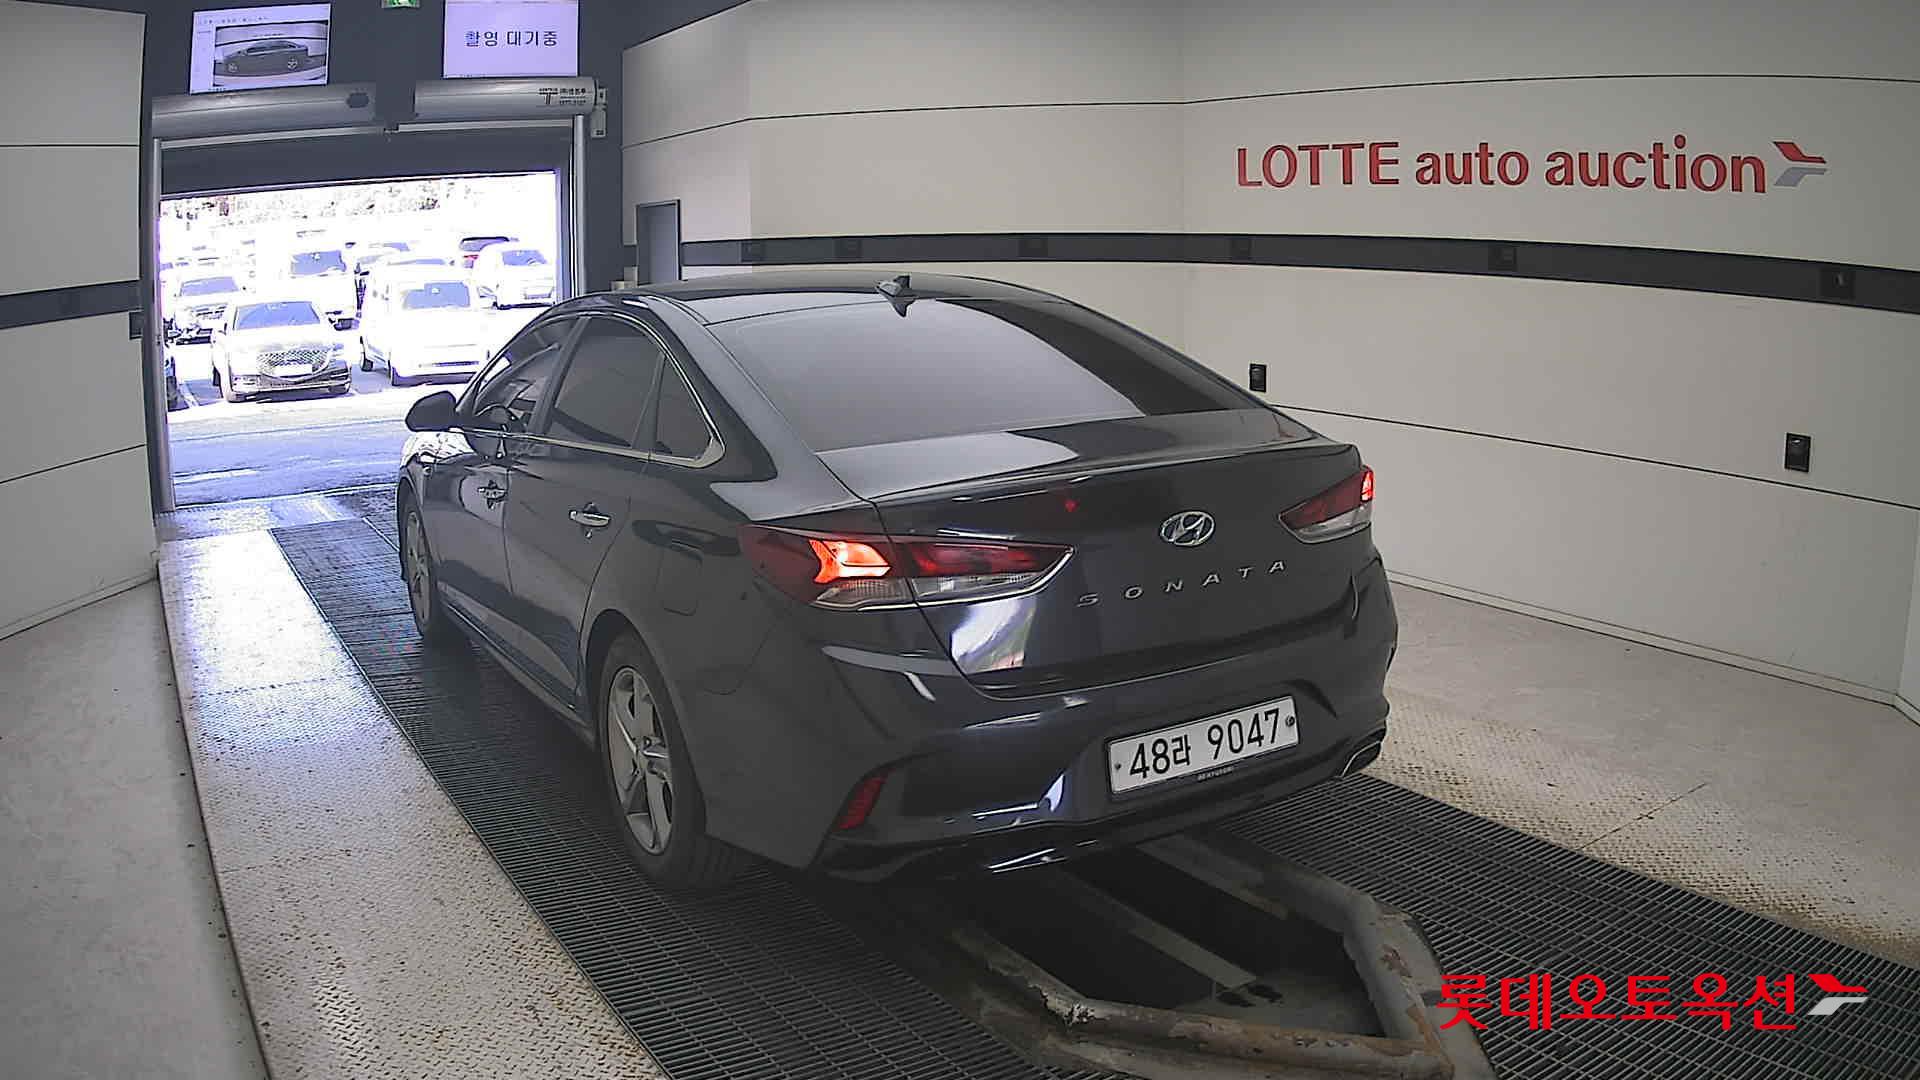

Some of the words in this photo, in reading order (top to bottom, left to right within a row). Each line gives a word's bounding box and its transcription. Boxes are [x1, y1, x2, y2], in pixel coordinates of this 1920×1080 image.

[506, 30, 558, 47] 대기중
[1237, 141, 1400, 188] LOTTE
[1415, 142, 1529, 187] auto
[1544, 134, 1767, 194] auction
[1076, 560, 1286, 608] SONATA
[1129, 734, 1192, 779] 48라
[1207, 708, 1280, 760] 9047
